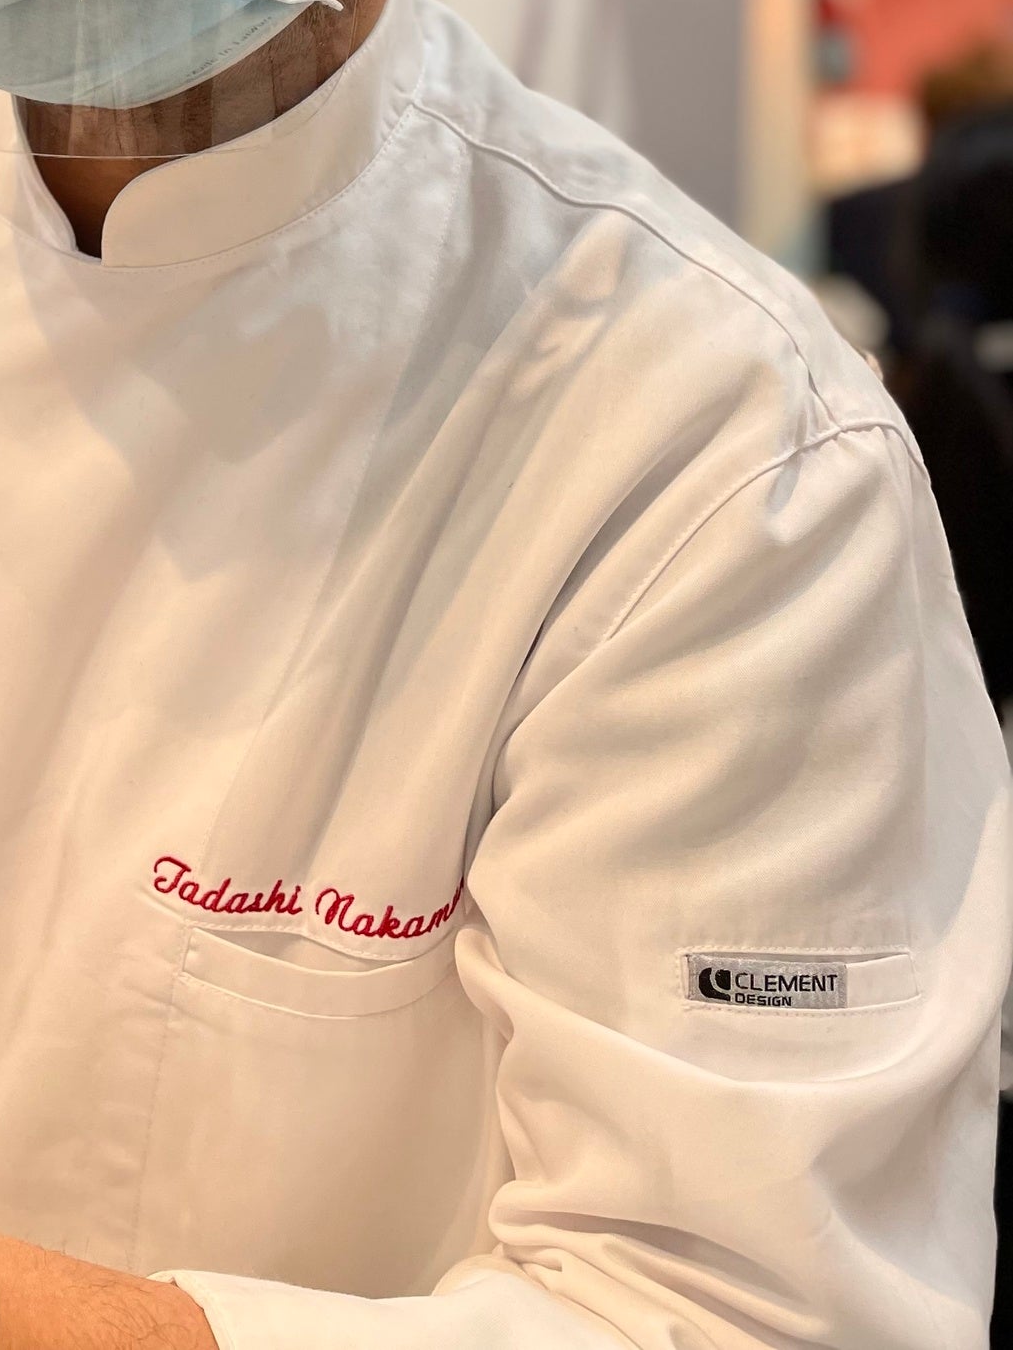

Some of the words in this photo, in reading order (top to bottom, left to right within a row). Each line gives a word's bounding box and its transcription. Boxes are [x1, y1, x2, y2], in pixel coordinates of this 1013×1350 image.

[153, 856, 303, 916] Tadashi
[734, 972, 839, 993] CLEMENT
[734, 992, 793, 1008] DESIGN
